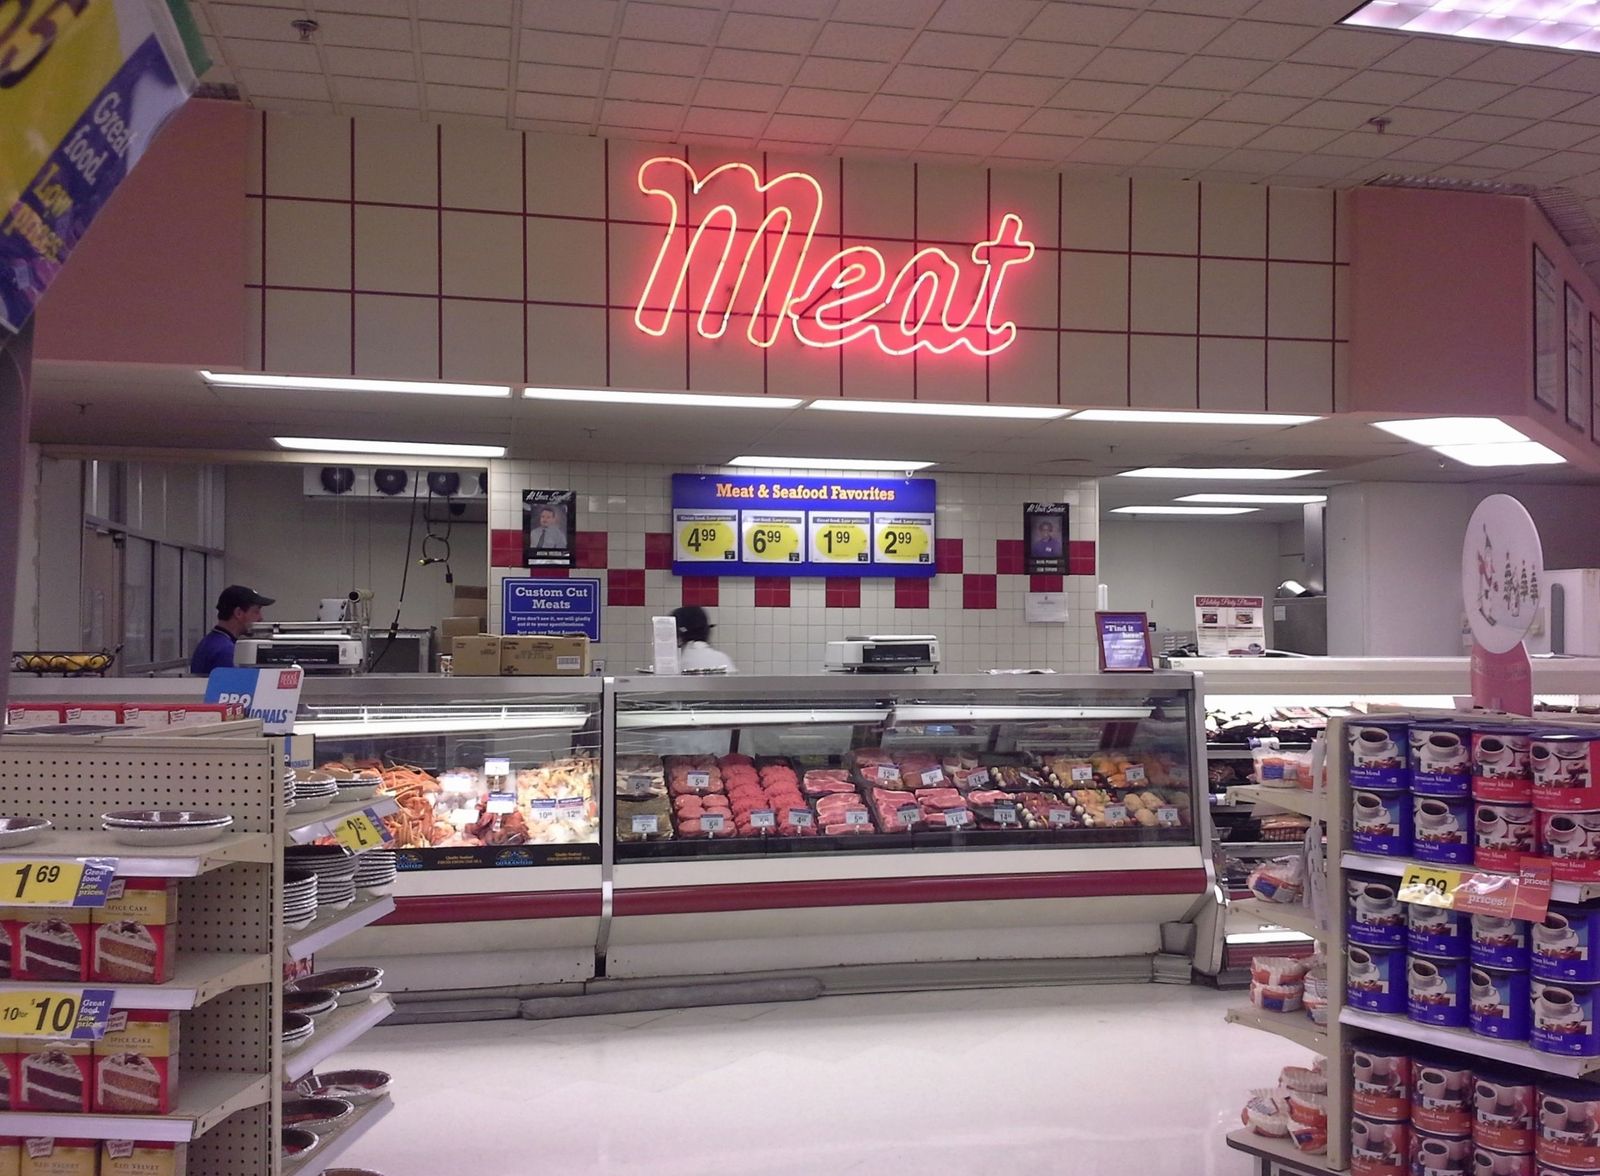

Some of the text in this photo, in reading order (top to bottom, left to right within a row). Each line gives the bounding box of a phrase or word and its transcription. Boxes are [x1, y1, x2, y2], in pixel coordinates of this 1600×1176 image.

[33, 162, 74, 218] Low
[634, 157, 1034, 356] Meat
[716, 483, 895, 501] Meat & Seafood Favorites
[515, 587, 588, 597] Custom Cut
[532, 599, 571, 609] Meats
